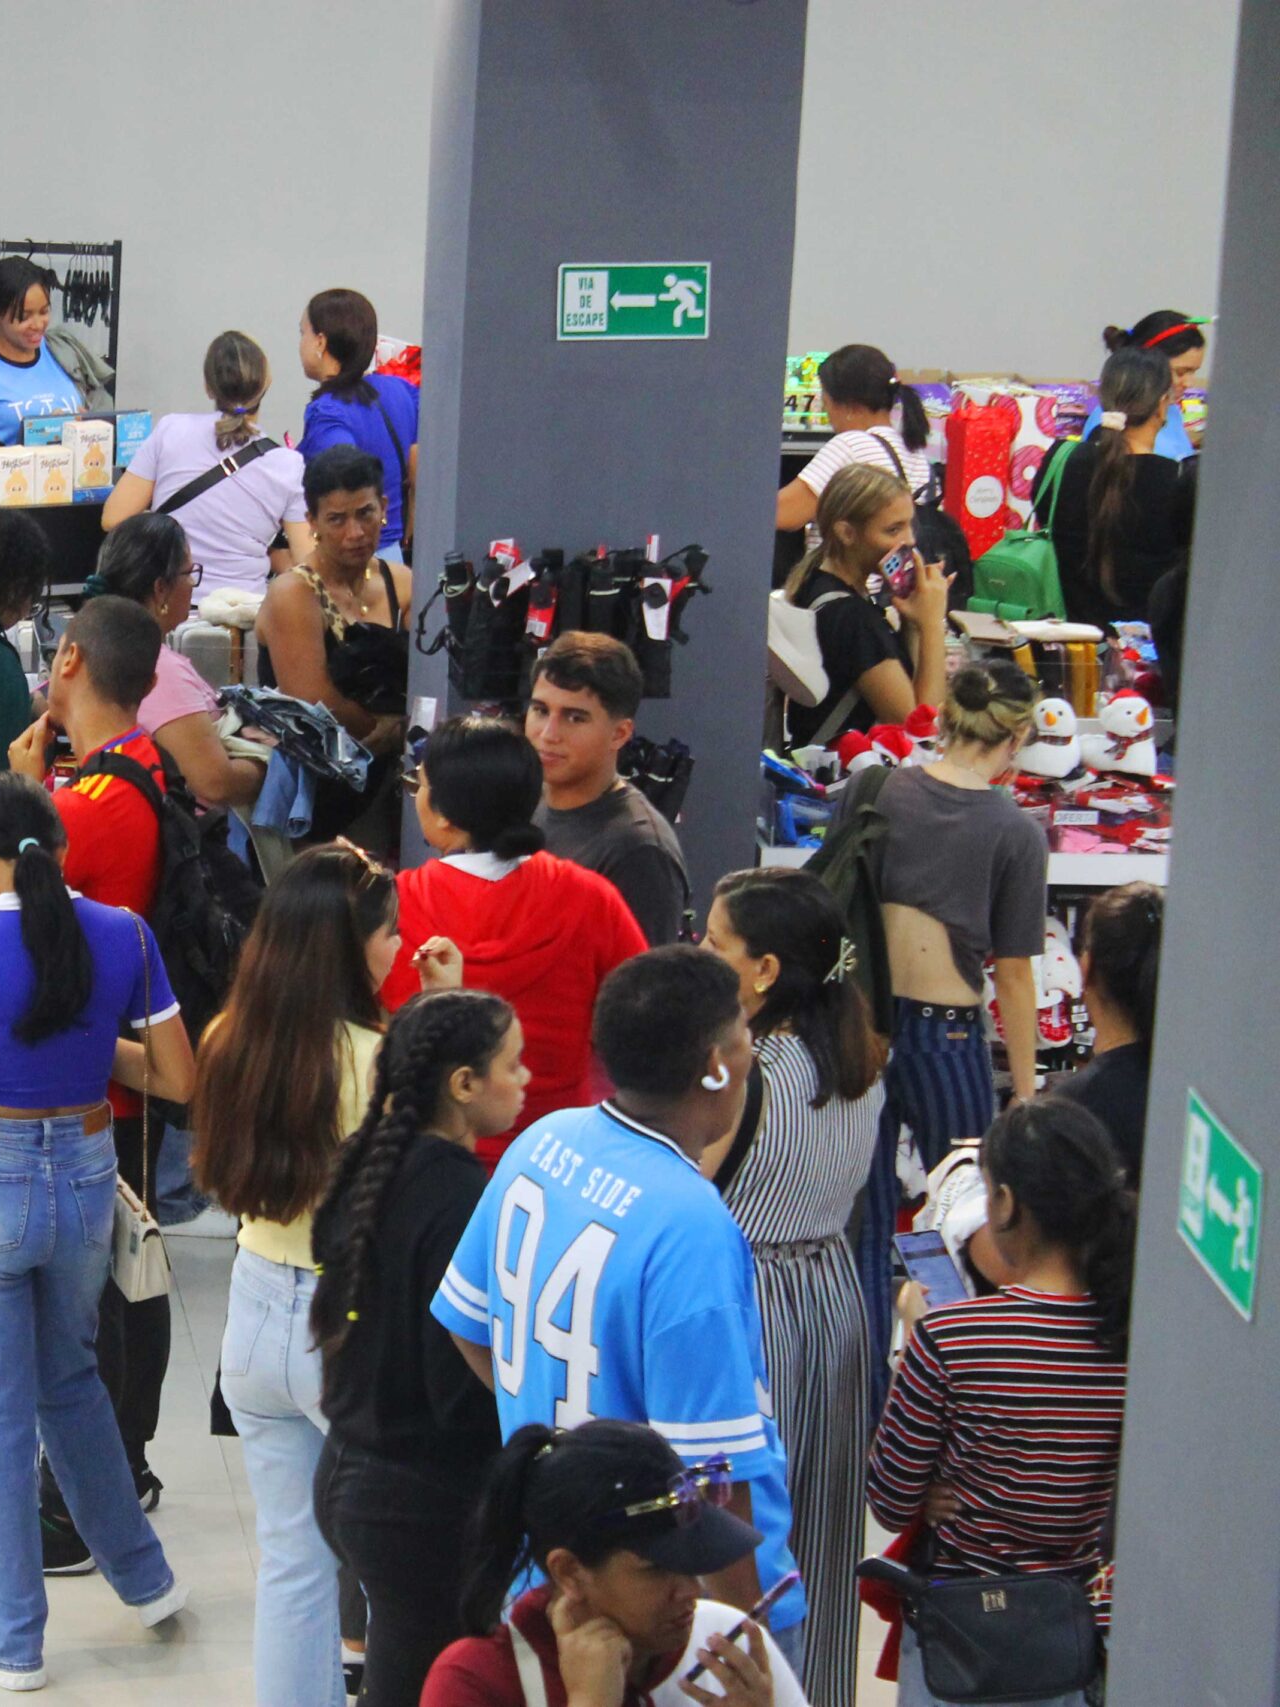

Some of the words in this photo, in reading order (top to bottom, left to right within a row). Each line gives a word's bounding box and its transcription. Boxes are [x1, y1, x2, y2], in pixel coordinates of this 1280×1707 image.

[578, 277, 594, 290] VIA
[579, 295, 592, 308] DE
[566, 313, 605, 327] ESCAPE
[529, 1132, 584, 1187] EAST
[581, 1167, 642, 1218] SIDE
[492, 1173, 618, 1430] 94
